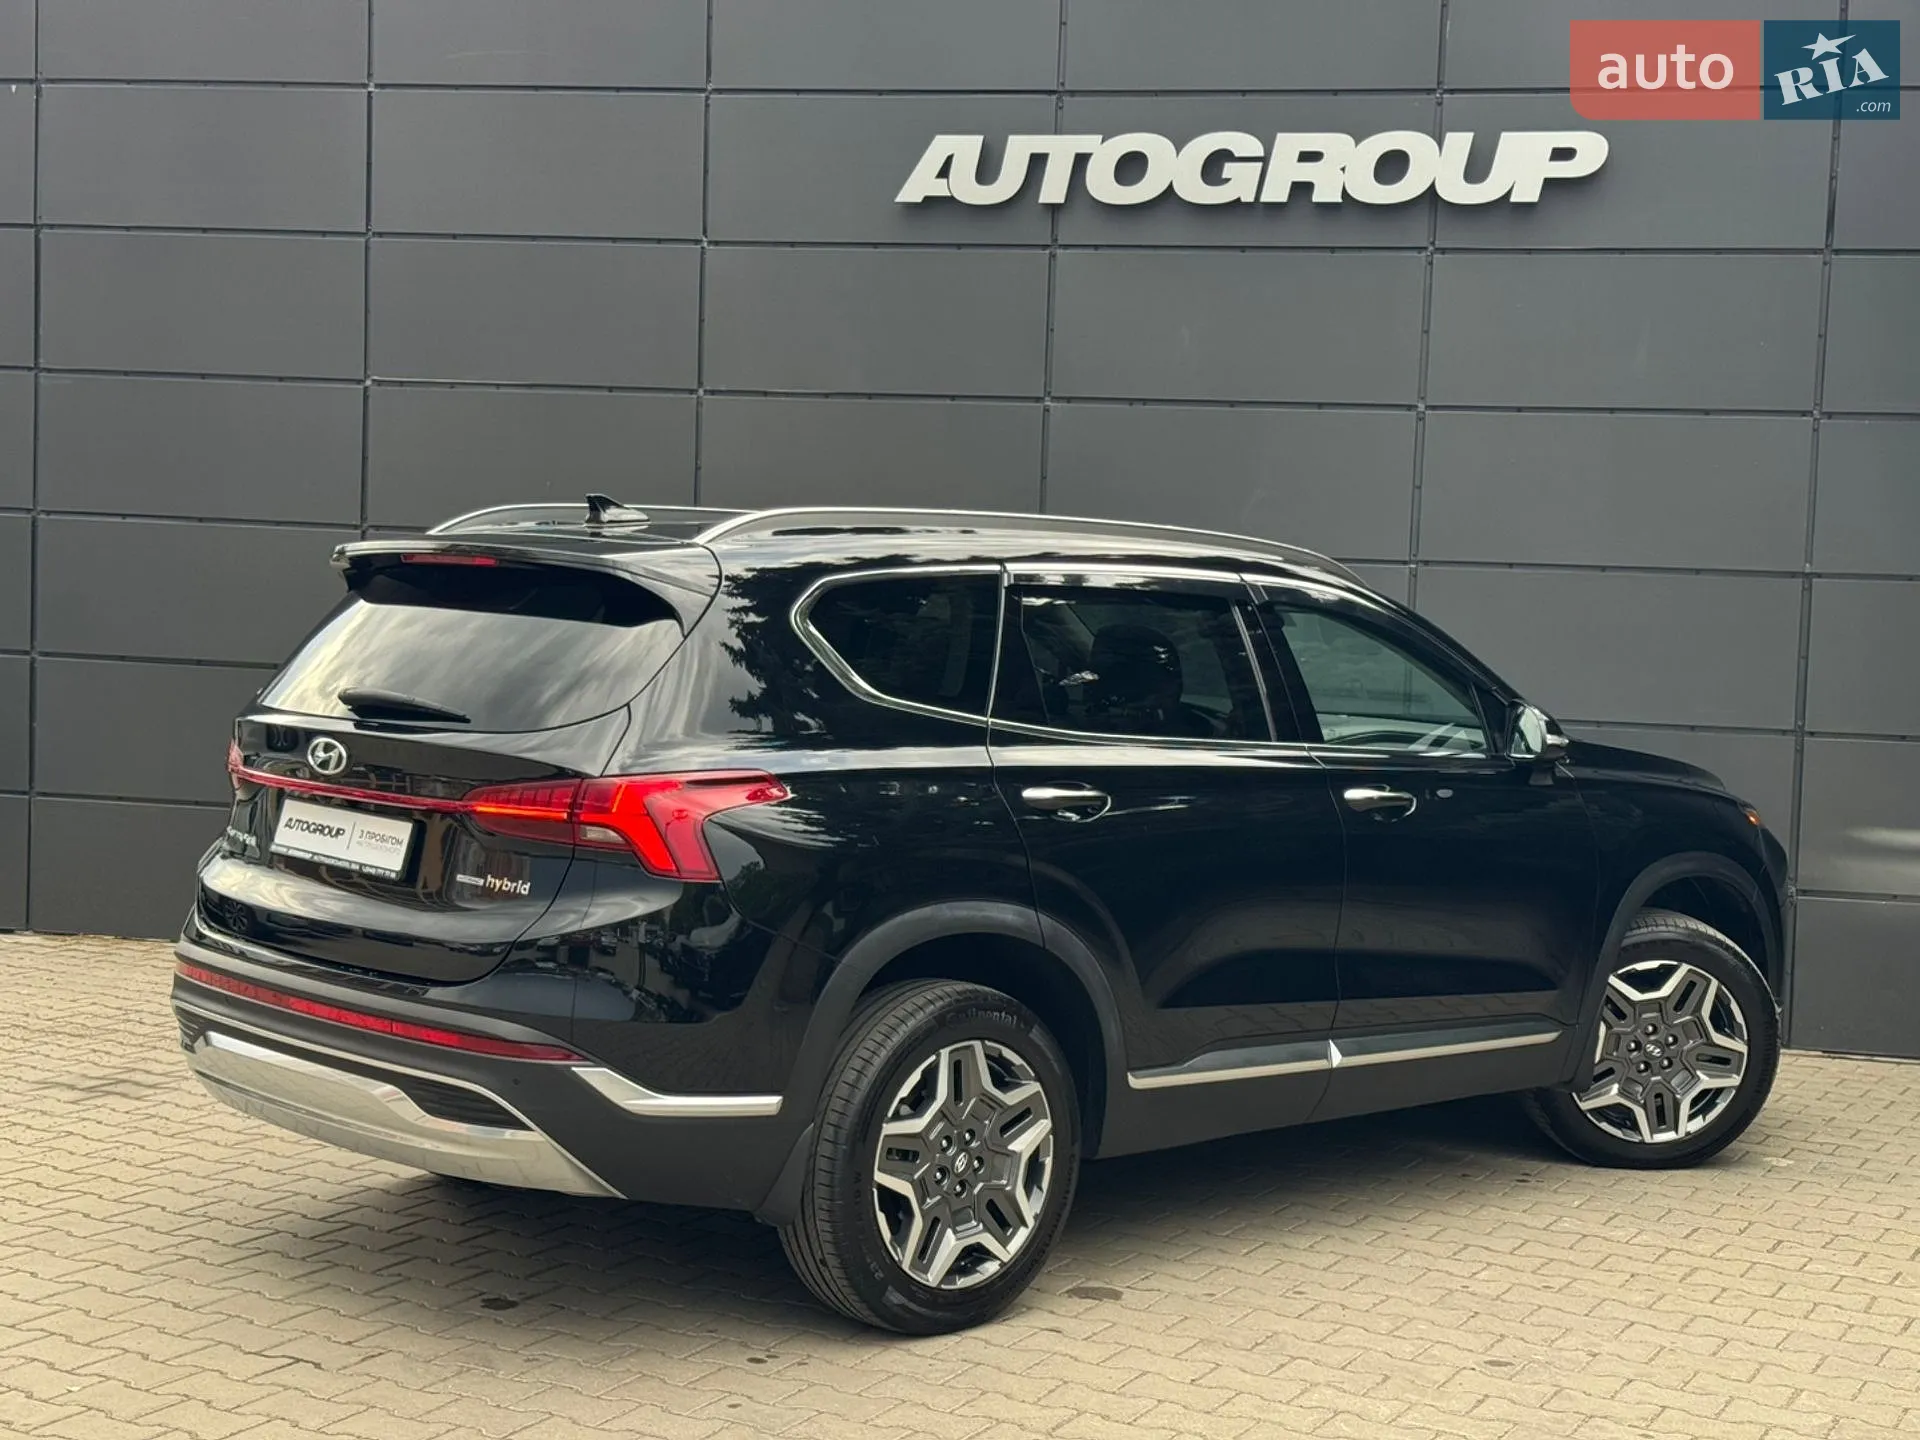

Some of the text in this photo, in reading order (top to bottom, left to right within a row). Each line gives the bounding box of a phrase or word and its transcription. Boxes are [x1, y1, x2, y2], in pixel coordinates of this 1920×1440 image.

[895, 131, 1609, 205] AUTOGROUP
[284, 817, 346, 839] AUTOGROUP
[485, 873, 531, 896] hybrid
